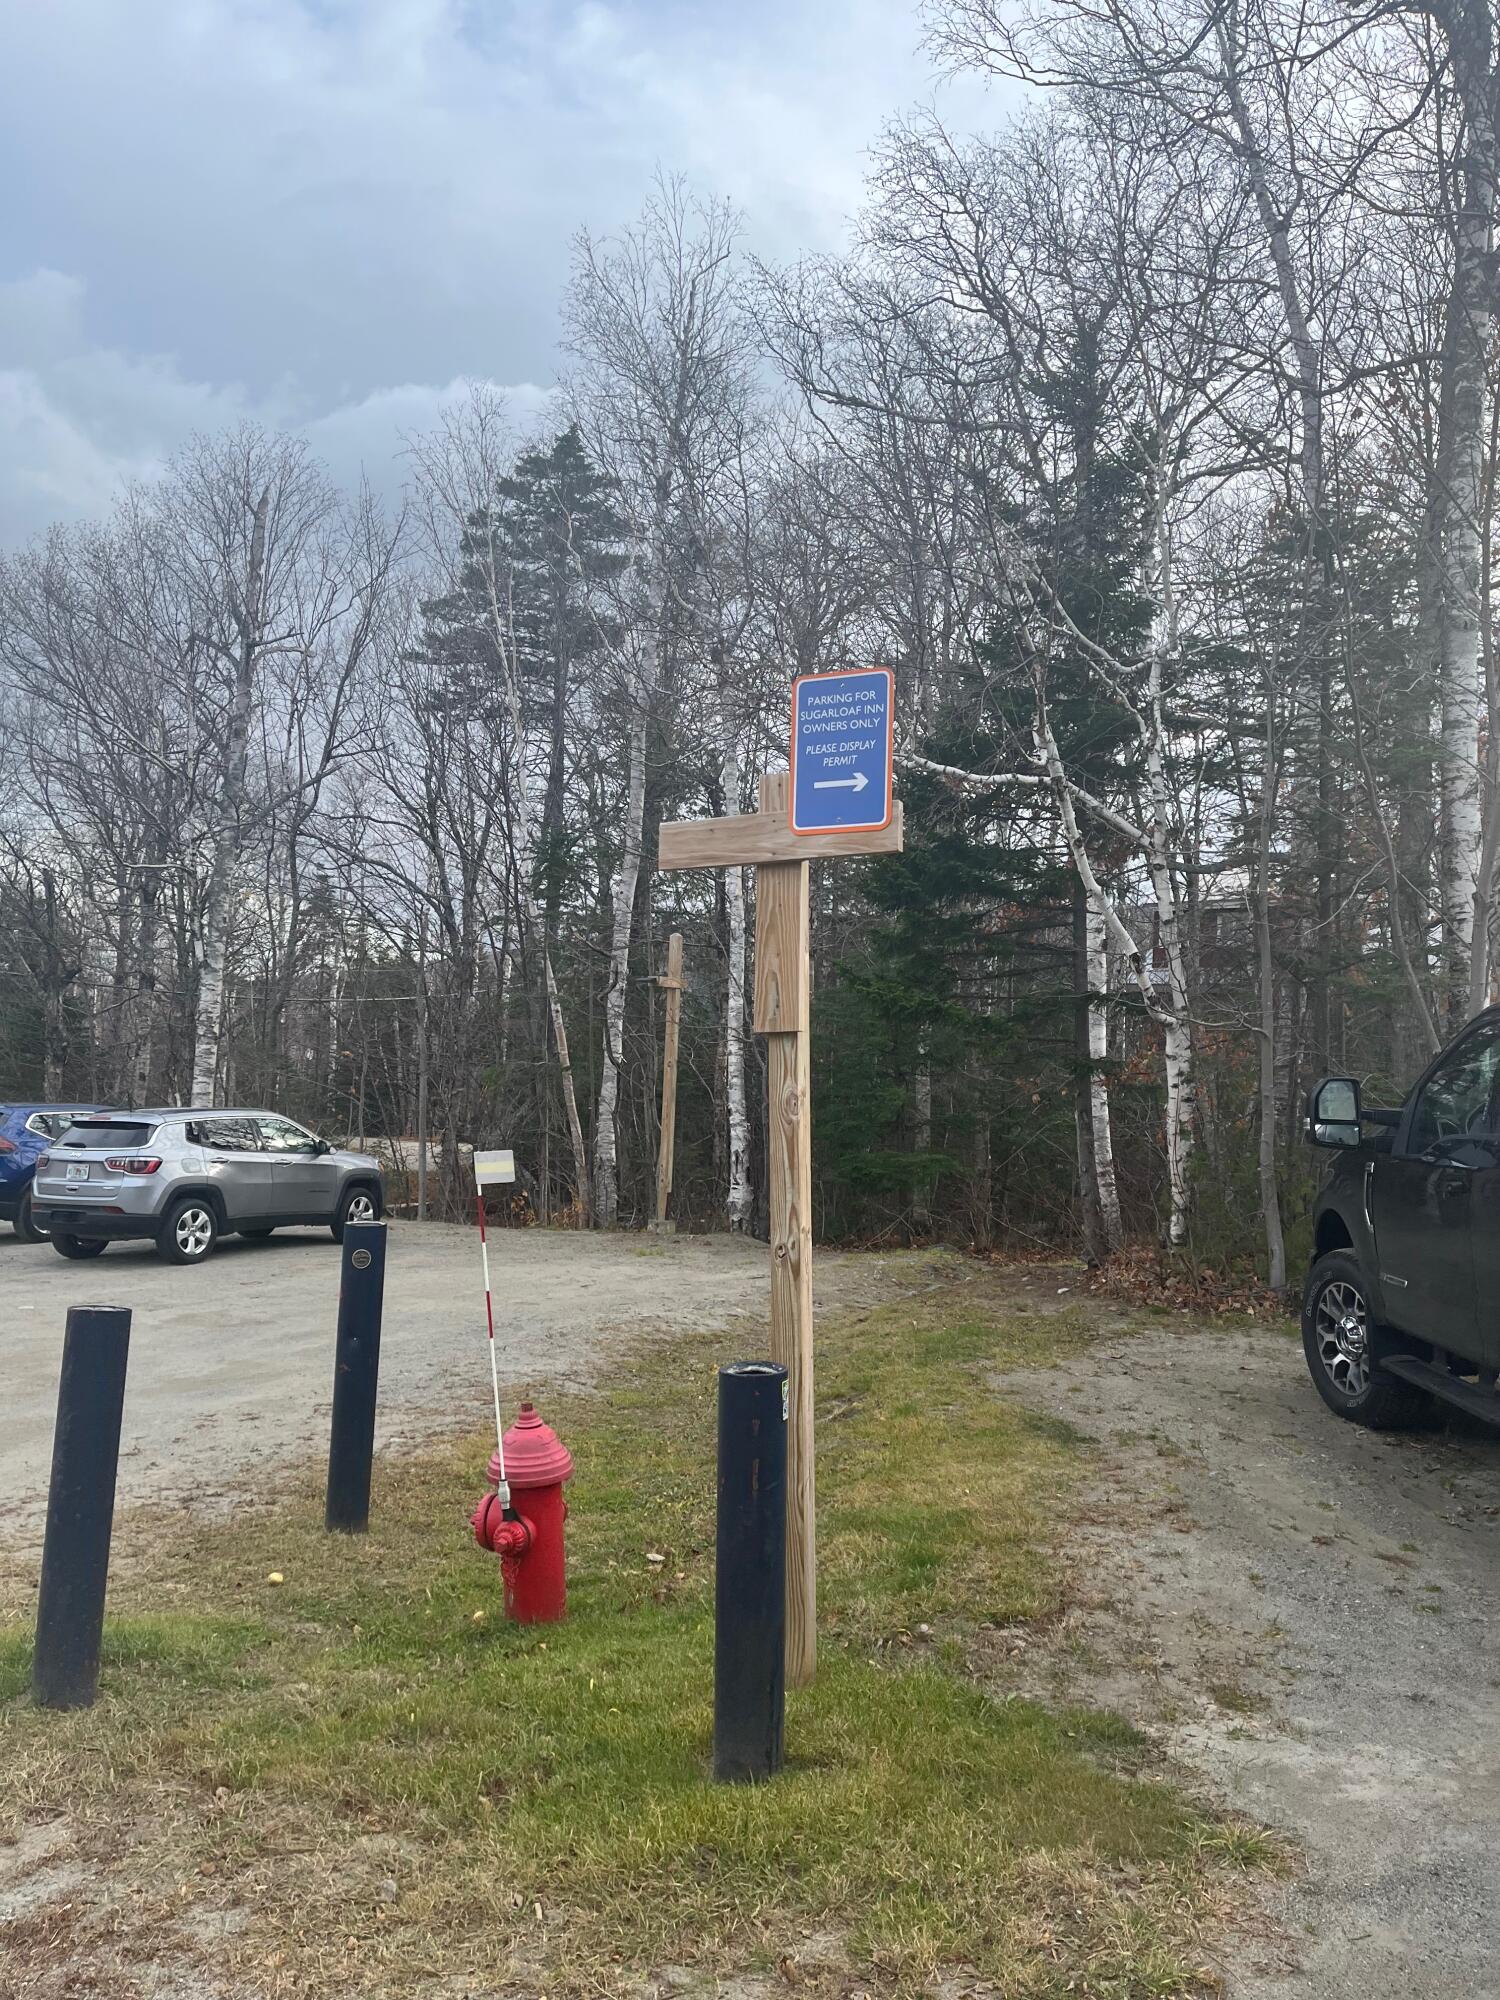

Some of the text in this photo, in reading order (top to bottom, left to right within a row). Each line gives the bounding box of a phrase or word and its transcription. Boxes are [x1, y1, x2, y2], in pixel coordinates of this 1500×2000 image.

[807, 691, 876, 707] PARKING FOR
[800, 704, 884, 721] SUGARLOAF INN
[803, 717, 881, 734] OWNERS ONLY
[805, 739, 876, 755] PLEASE DISPLAY
[823, 755, 858, 767] PERMIT
